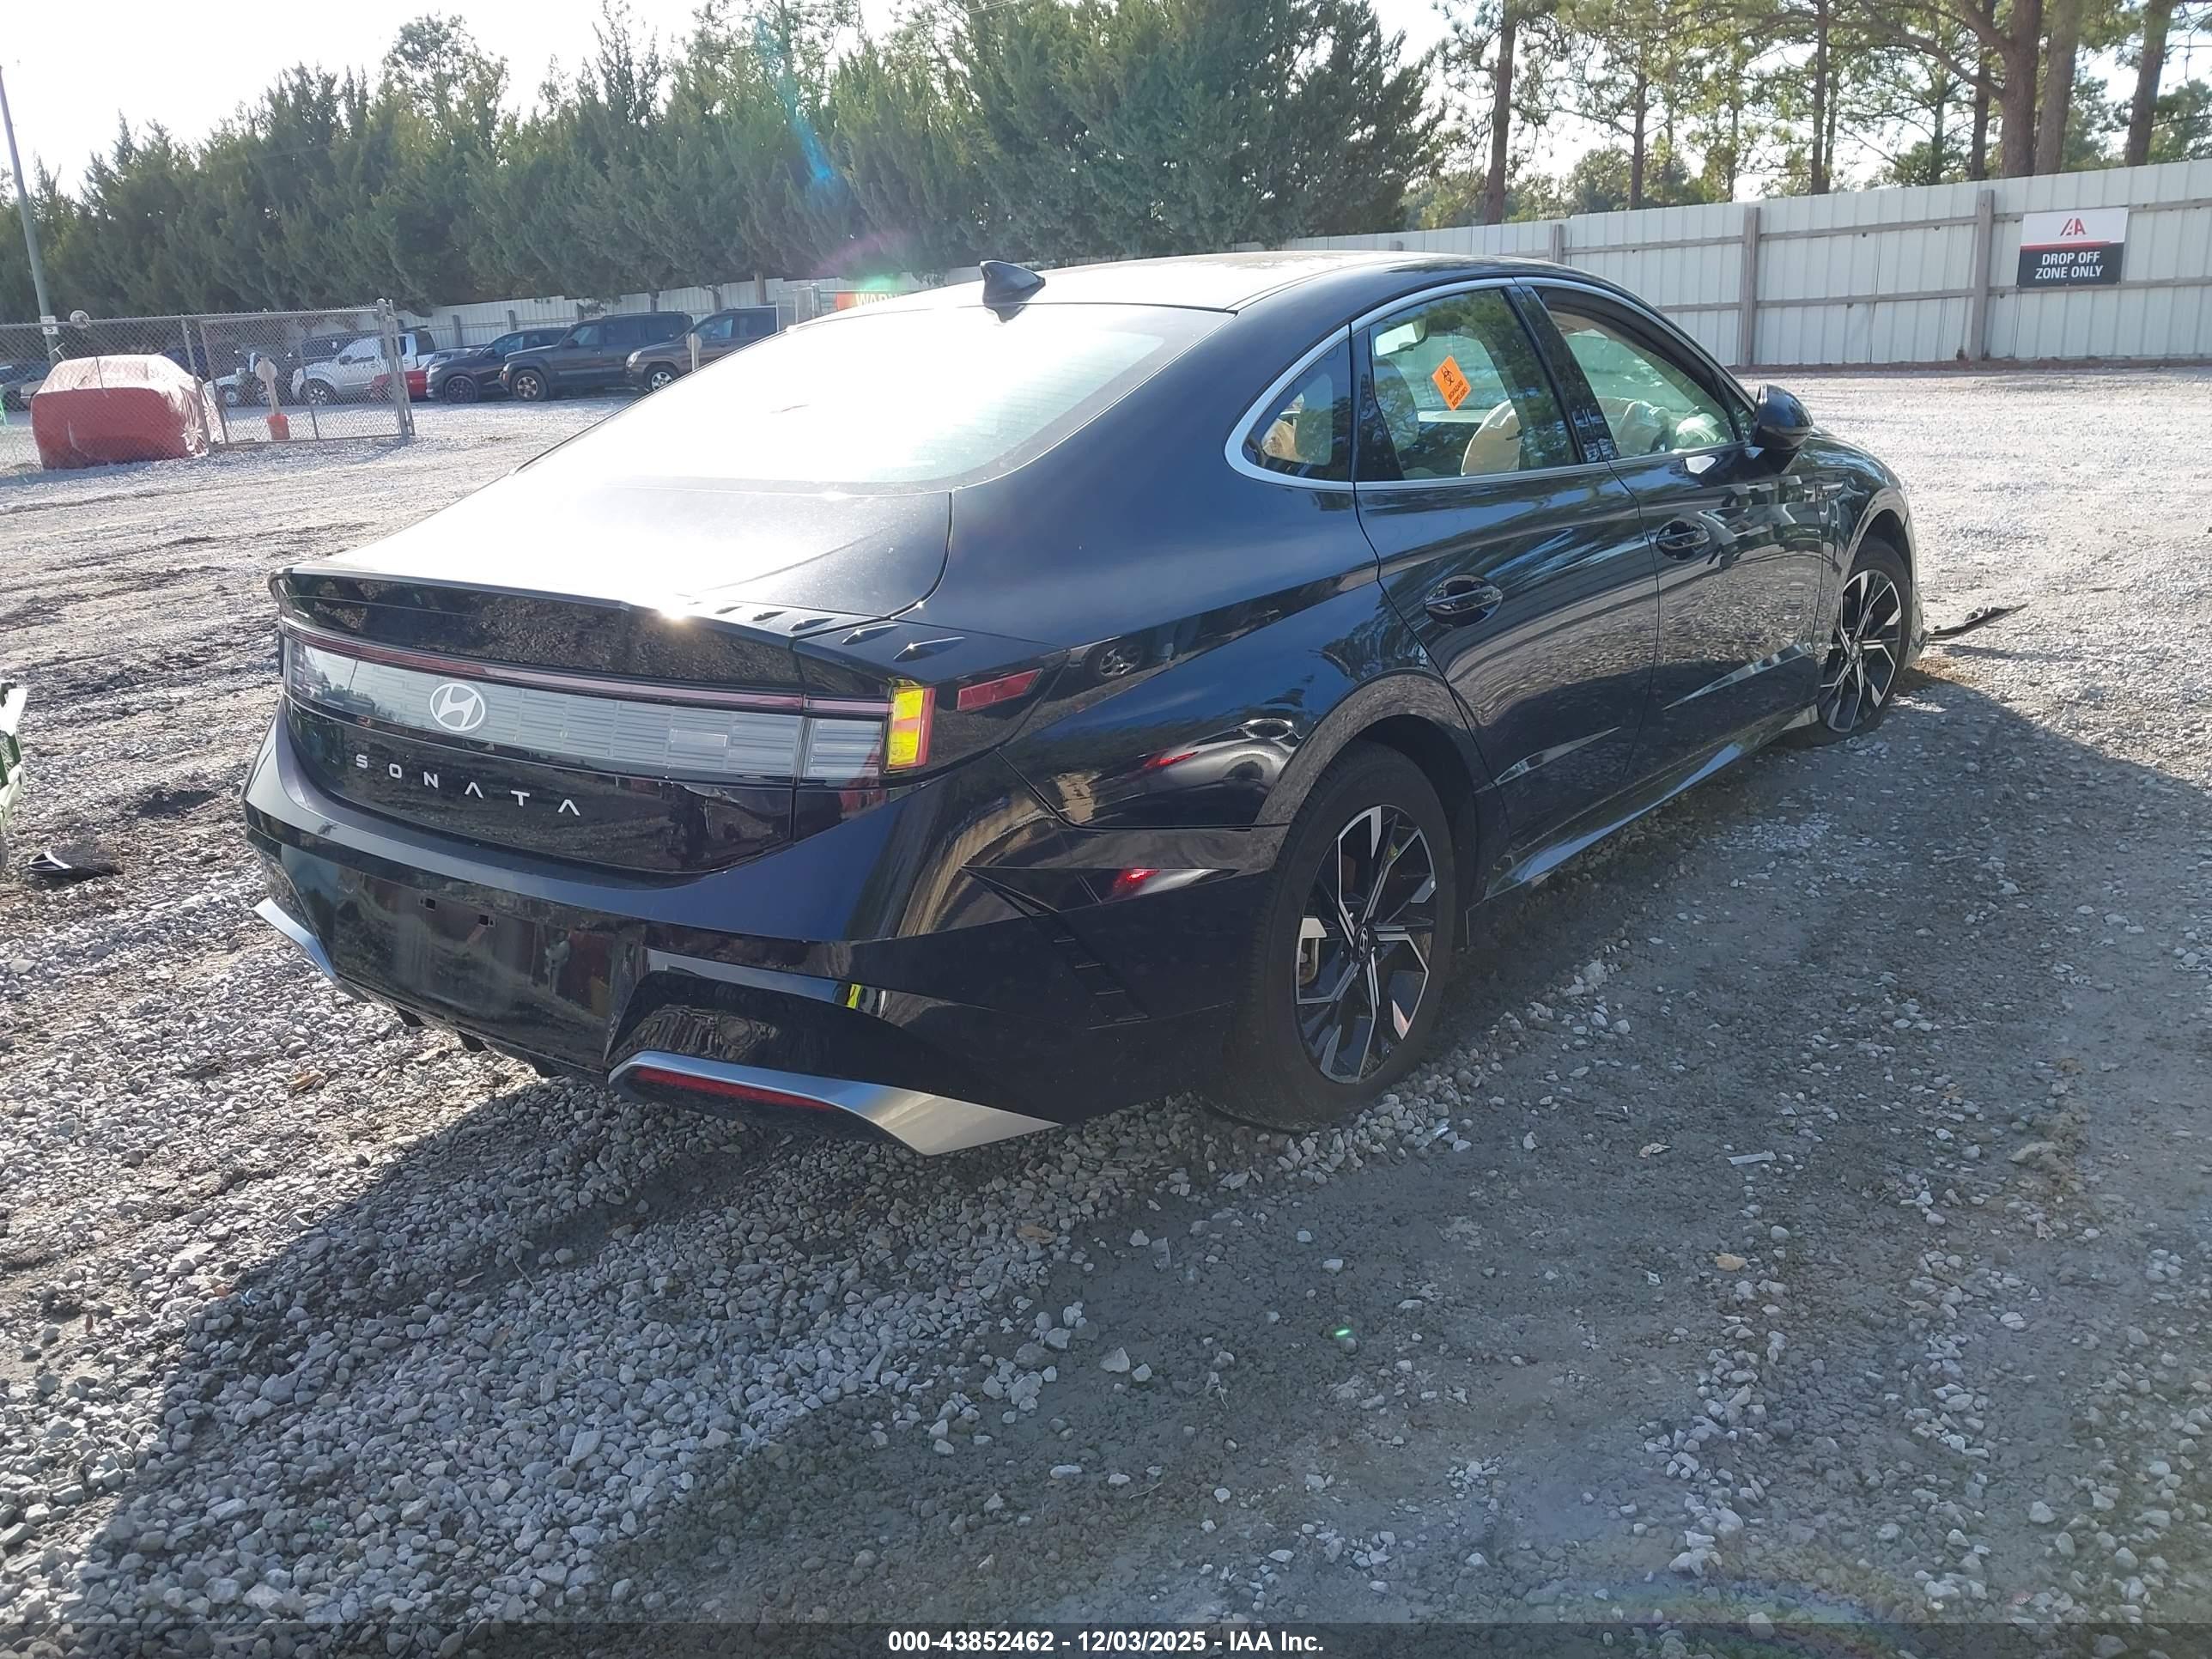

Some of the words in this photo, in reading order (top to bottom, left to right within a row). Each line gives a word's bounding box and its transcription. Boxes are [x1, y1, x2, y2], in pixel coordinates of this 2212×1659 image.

[2042, 252, 2075, 265] DROP
[2078, 251, 2101, 264] OFF
[2034, 267, 2069, 280] ZONE
[2071, 265, 2104, 278] ONLY
[355, 753, 581, 817] SONATA
